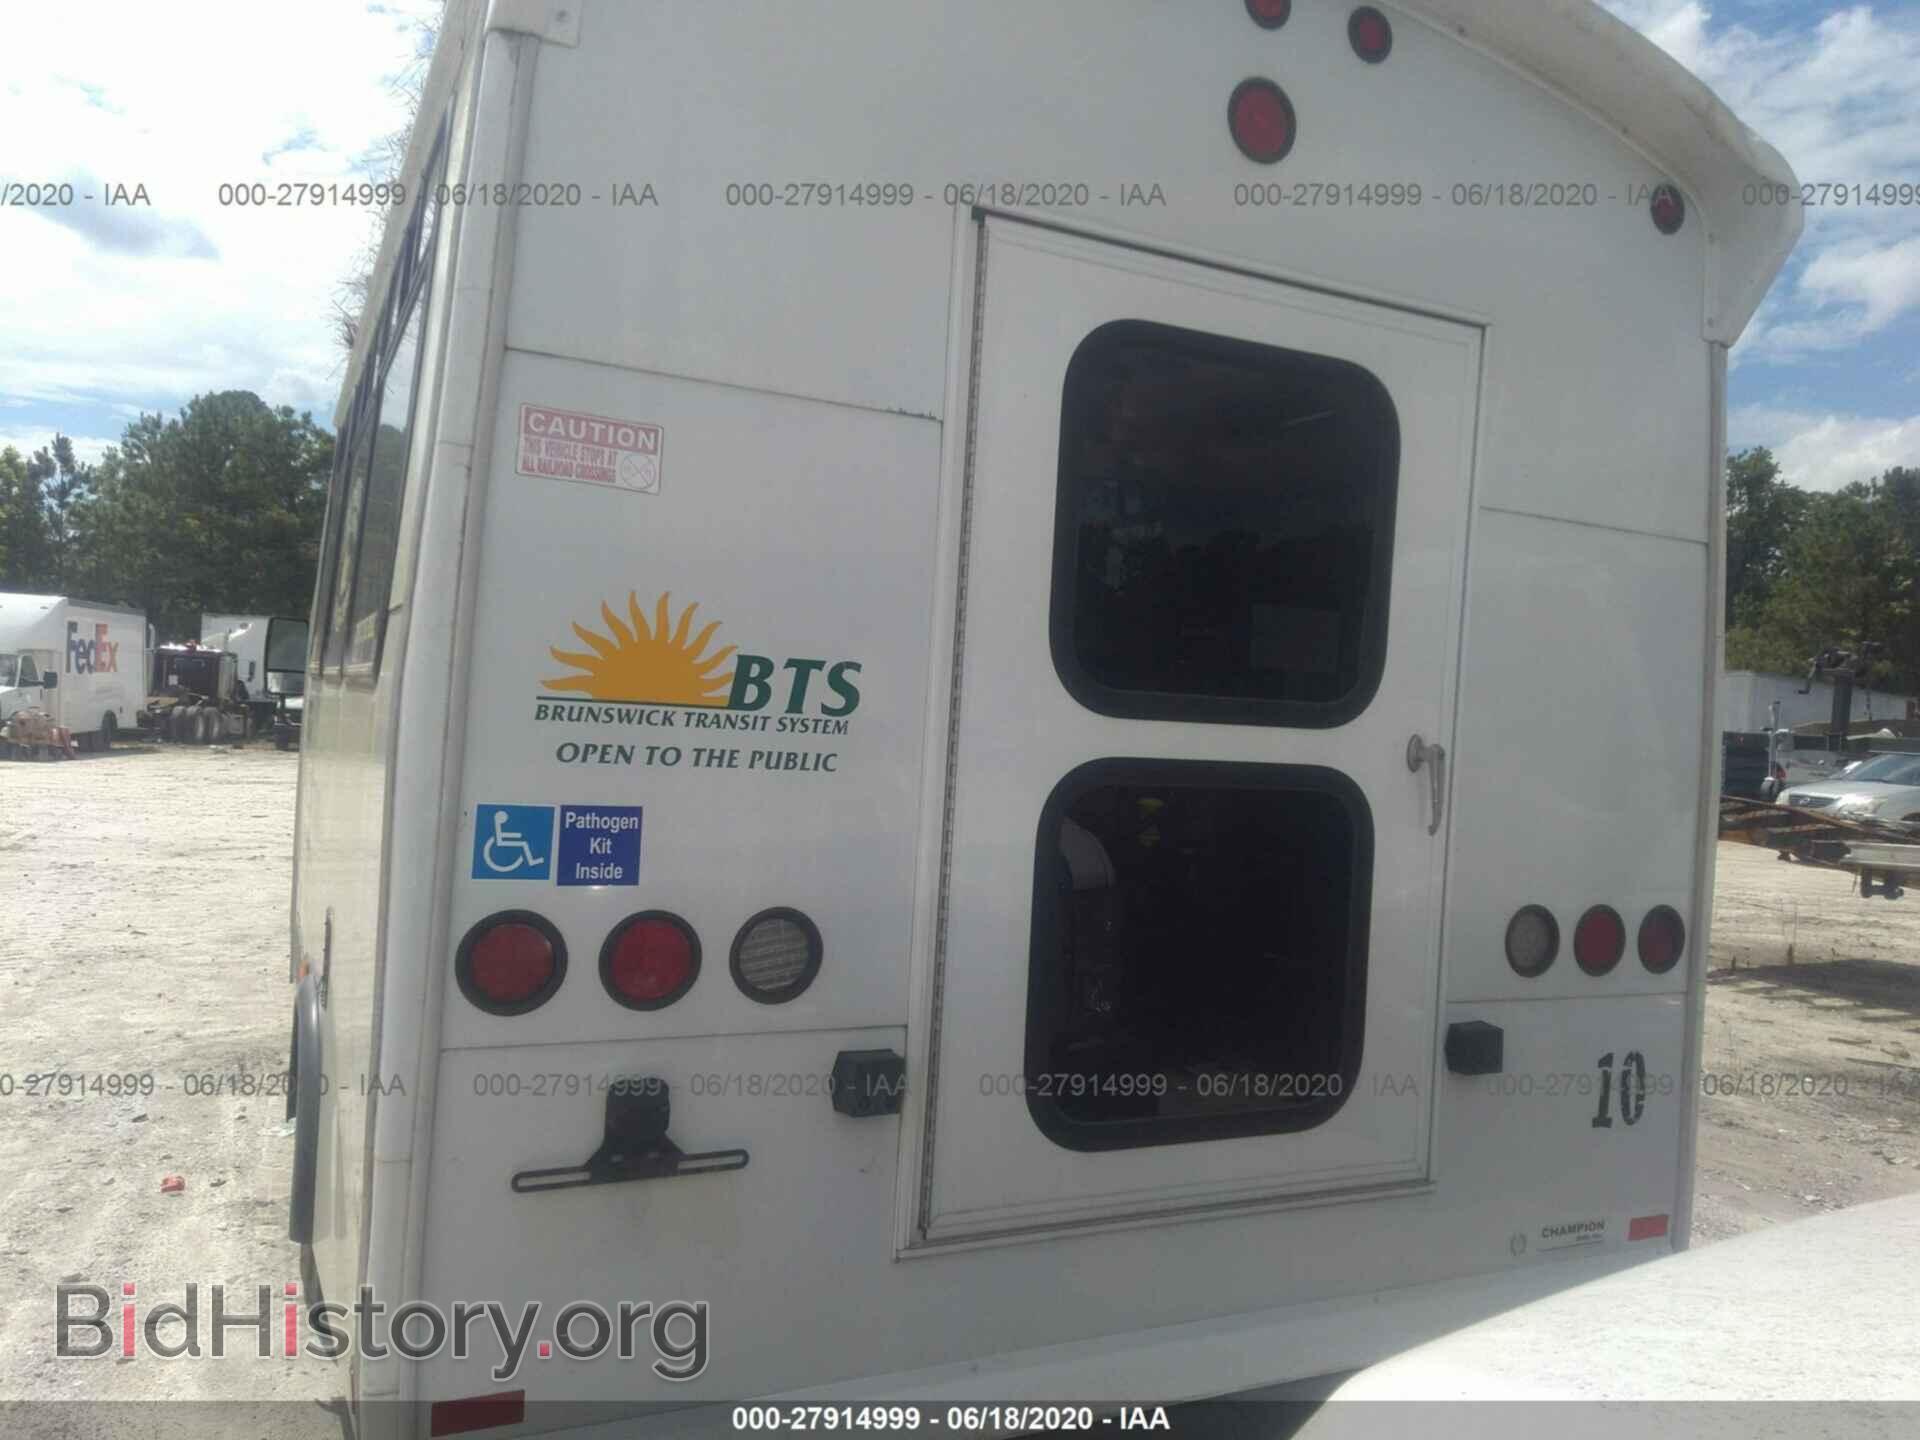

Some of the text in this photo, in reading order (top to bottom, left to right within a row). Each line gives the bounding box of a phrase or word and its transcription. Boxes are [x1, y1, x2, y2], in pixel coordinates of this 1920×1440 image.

[528, 412, 656, 450] CAUTION
[65, 620, 119, 675] FedEx
[727, 654, 863, 718] BTS
[534, 703, 849, 736] BRUNSWICK TRANSIT SYSTEM
[555, 741, 839, 773] OPEN TO THE PUBLIC
[565, 811, 639, 834] Pathogen
[589, 837, 613, 855] Kit
[575, 862, 623, 880] Inside
[1592, 1051, 1646, 1129] 10
[1541, 1220, 1605, 1239] CHAMPION
